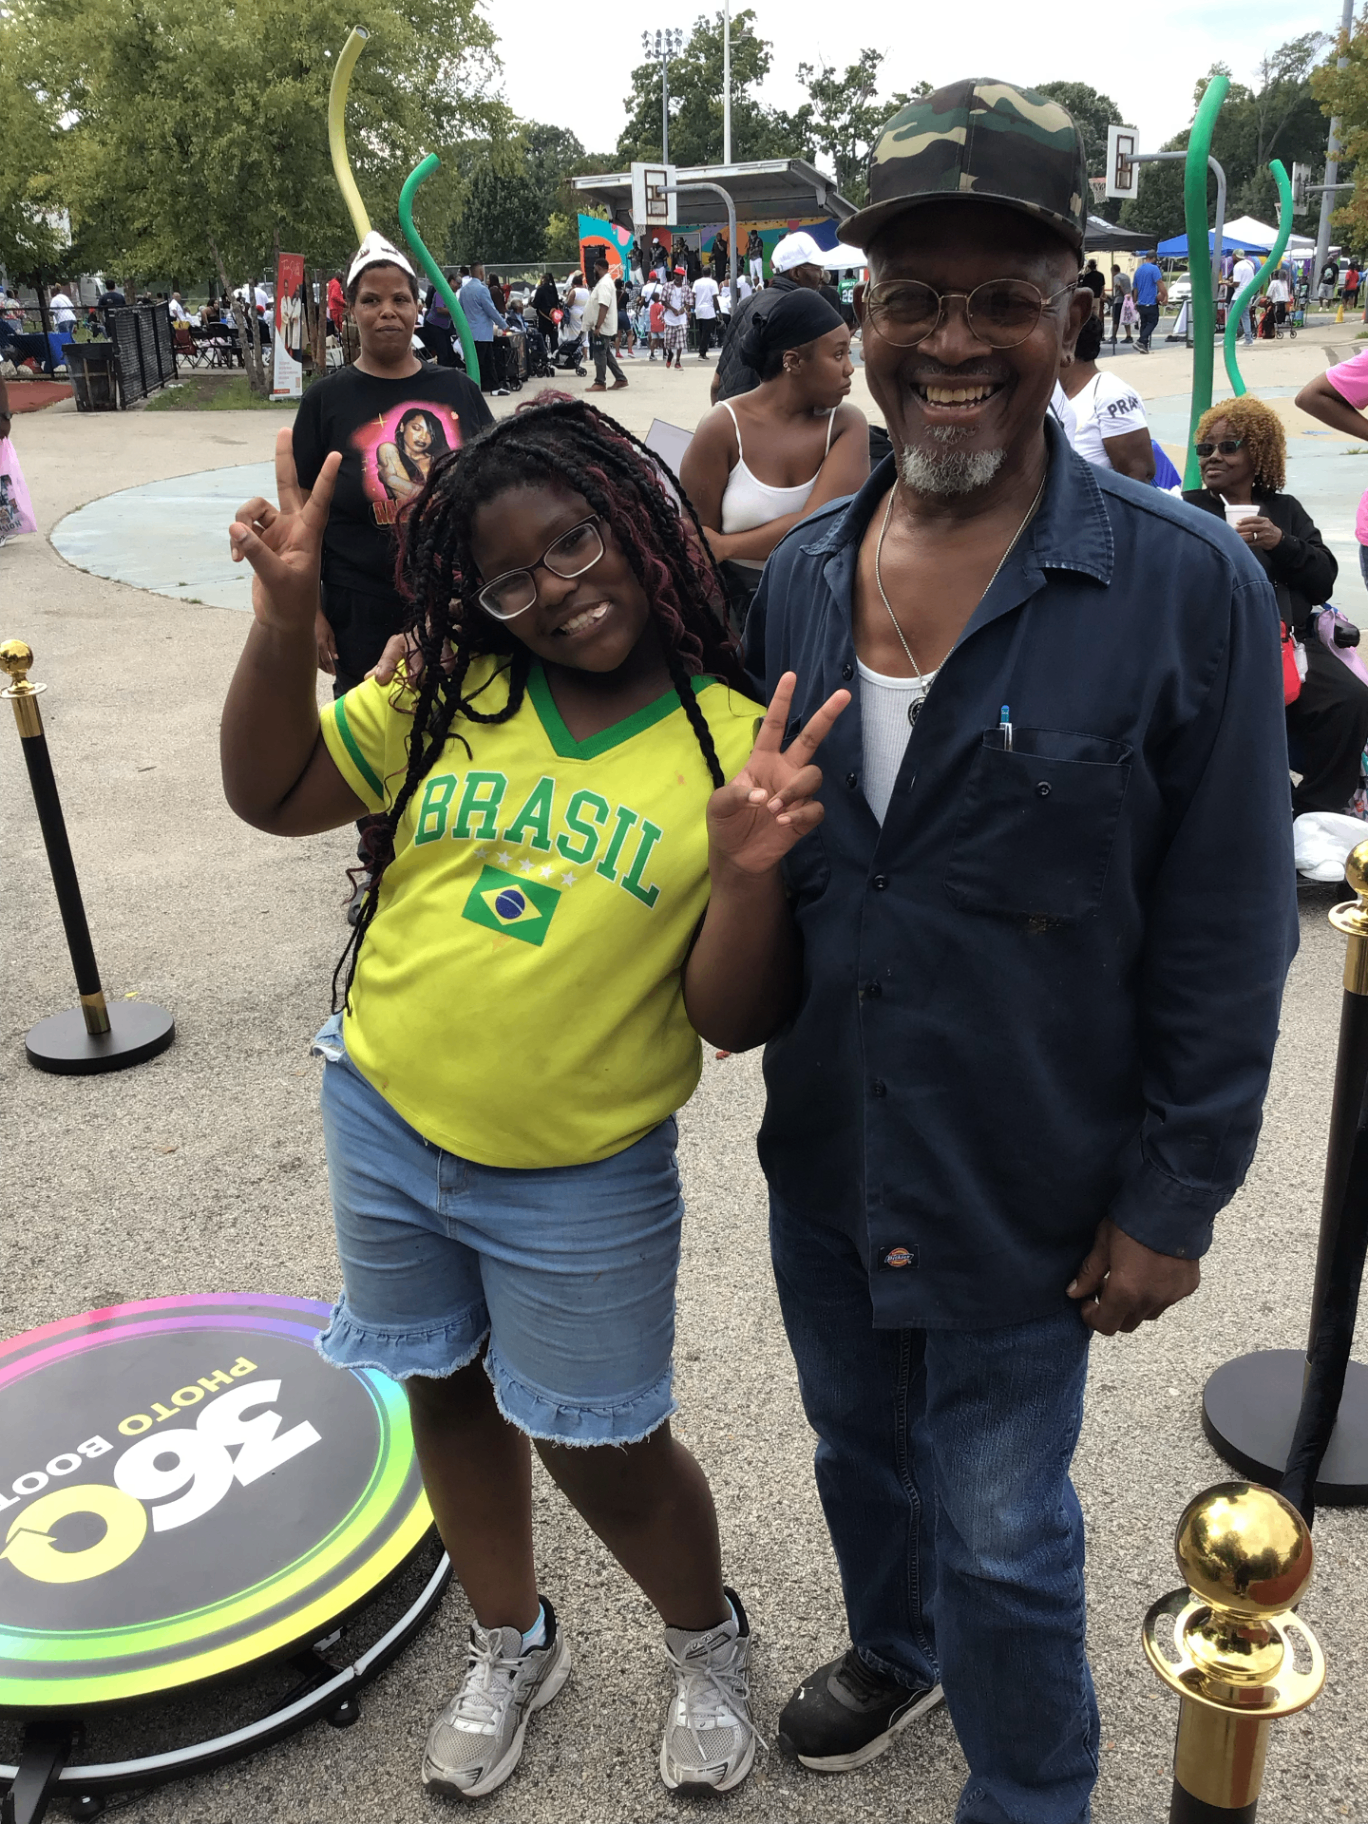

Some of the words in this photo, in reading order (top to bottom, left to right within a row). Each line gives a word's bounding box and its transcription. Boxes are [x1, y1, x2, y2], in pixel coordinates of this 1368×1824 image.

[414, 770, 664, 911] BRASIL
[118, 1356, 258, 1436] PHOTO
[0, 1379, 322, 1584] 360
